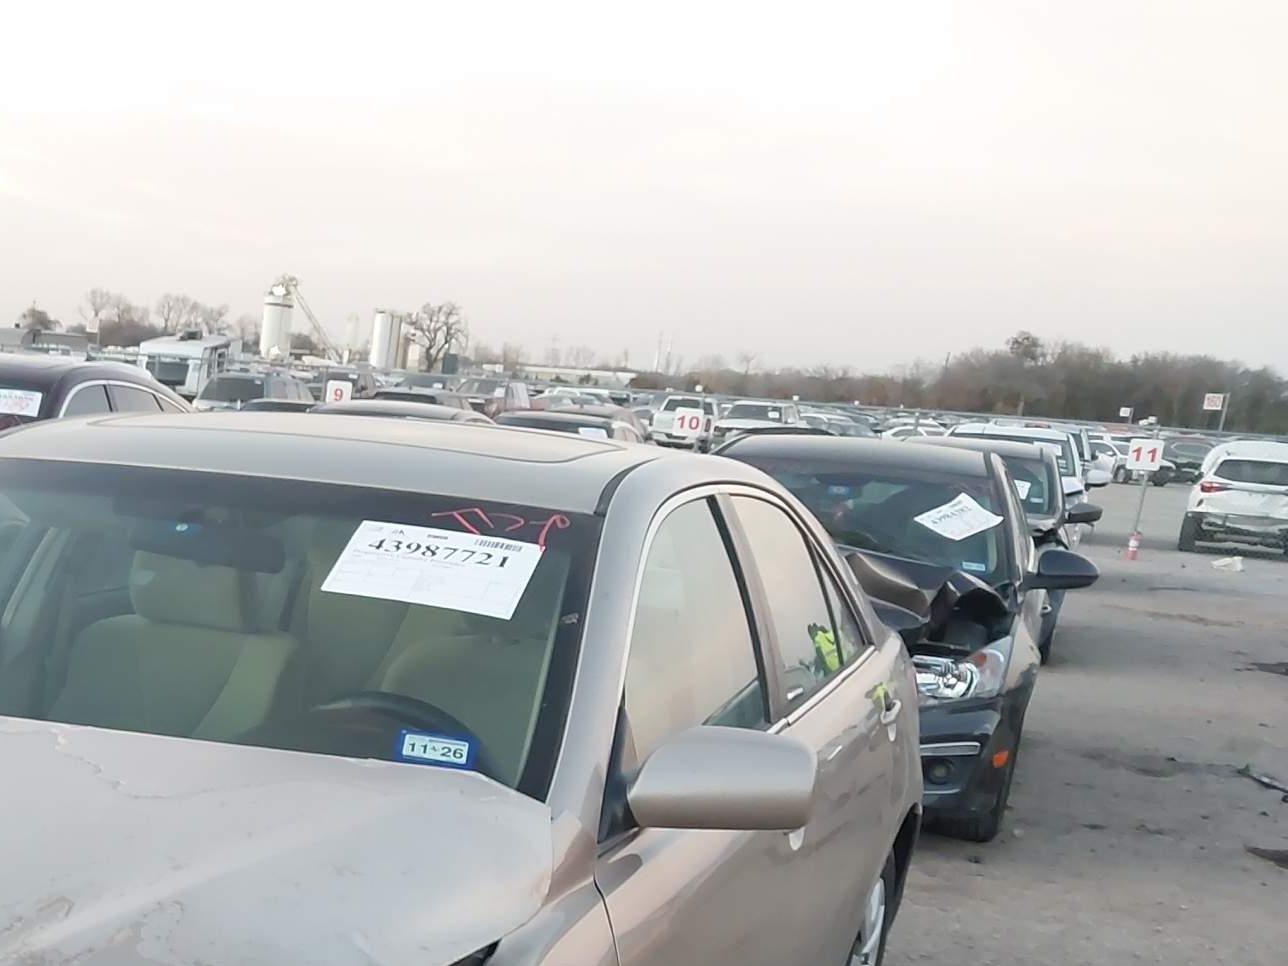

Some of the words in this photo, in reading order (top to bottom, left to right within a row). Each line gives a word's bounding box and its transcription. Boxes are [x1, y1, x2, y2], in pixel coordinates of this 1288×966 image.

[334, 388, 344, 401] 9
[677, 415, 700, 430] 10
[1132, 446, 1158, 463] 11
[367, 538, 510, 568] 43987721
